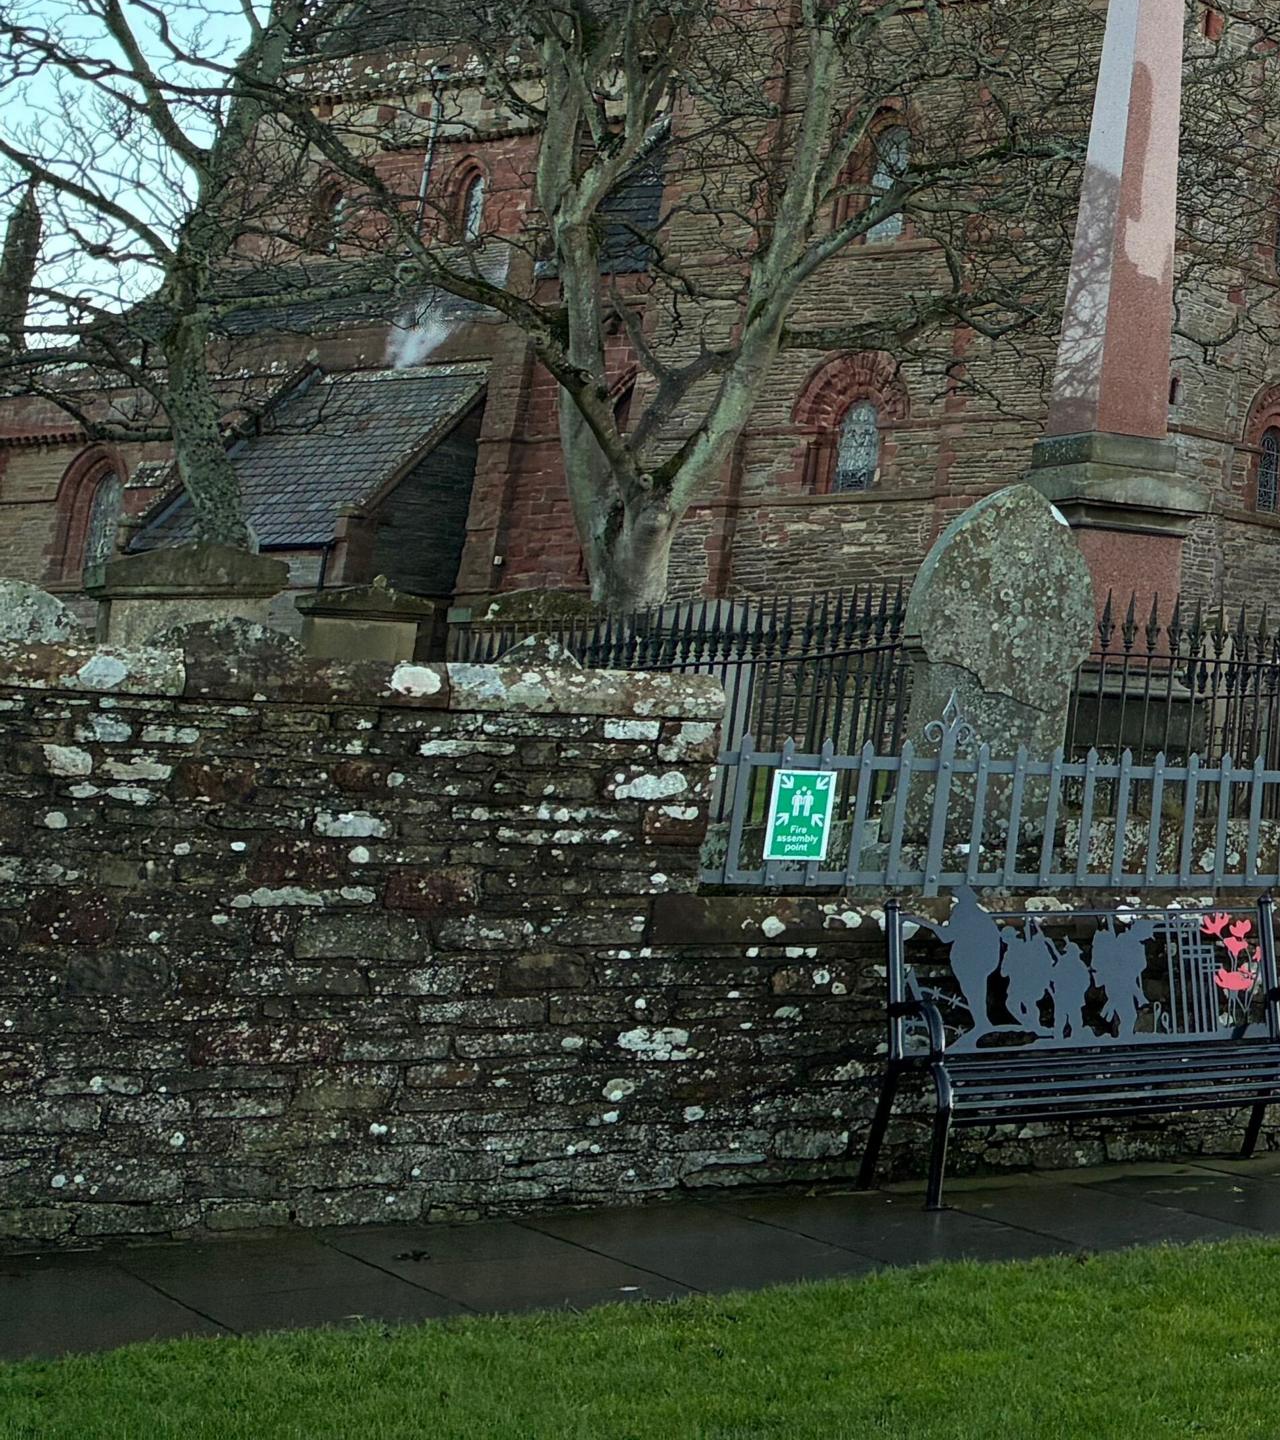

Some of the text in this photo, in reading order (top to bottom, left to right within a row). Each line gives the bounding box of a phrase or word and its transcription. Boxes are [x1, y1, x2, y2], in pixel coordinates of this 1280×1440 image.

[790, 825, 808, 834] Fire
[776, 834, 819, 845] assembly
[784, 843, 808, 853] point
